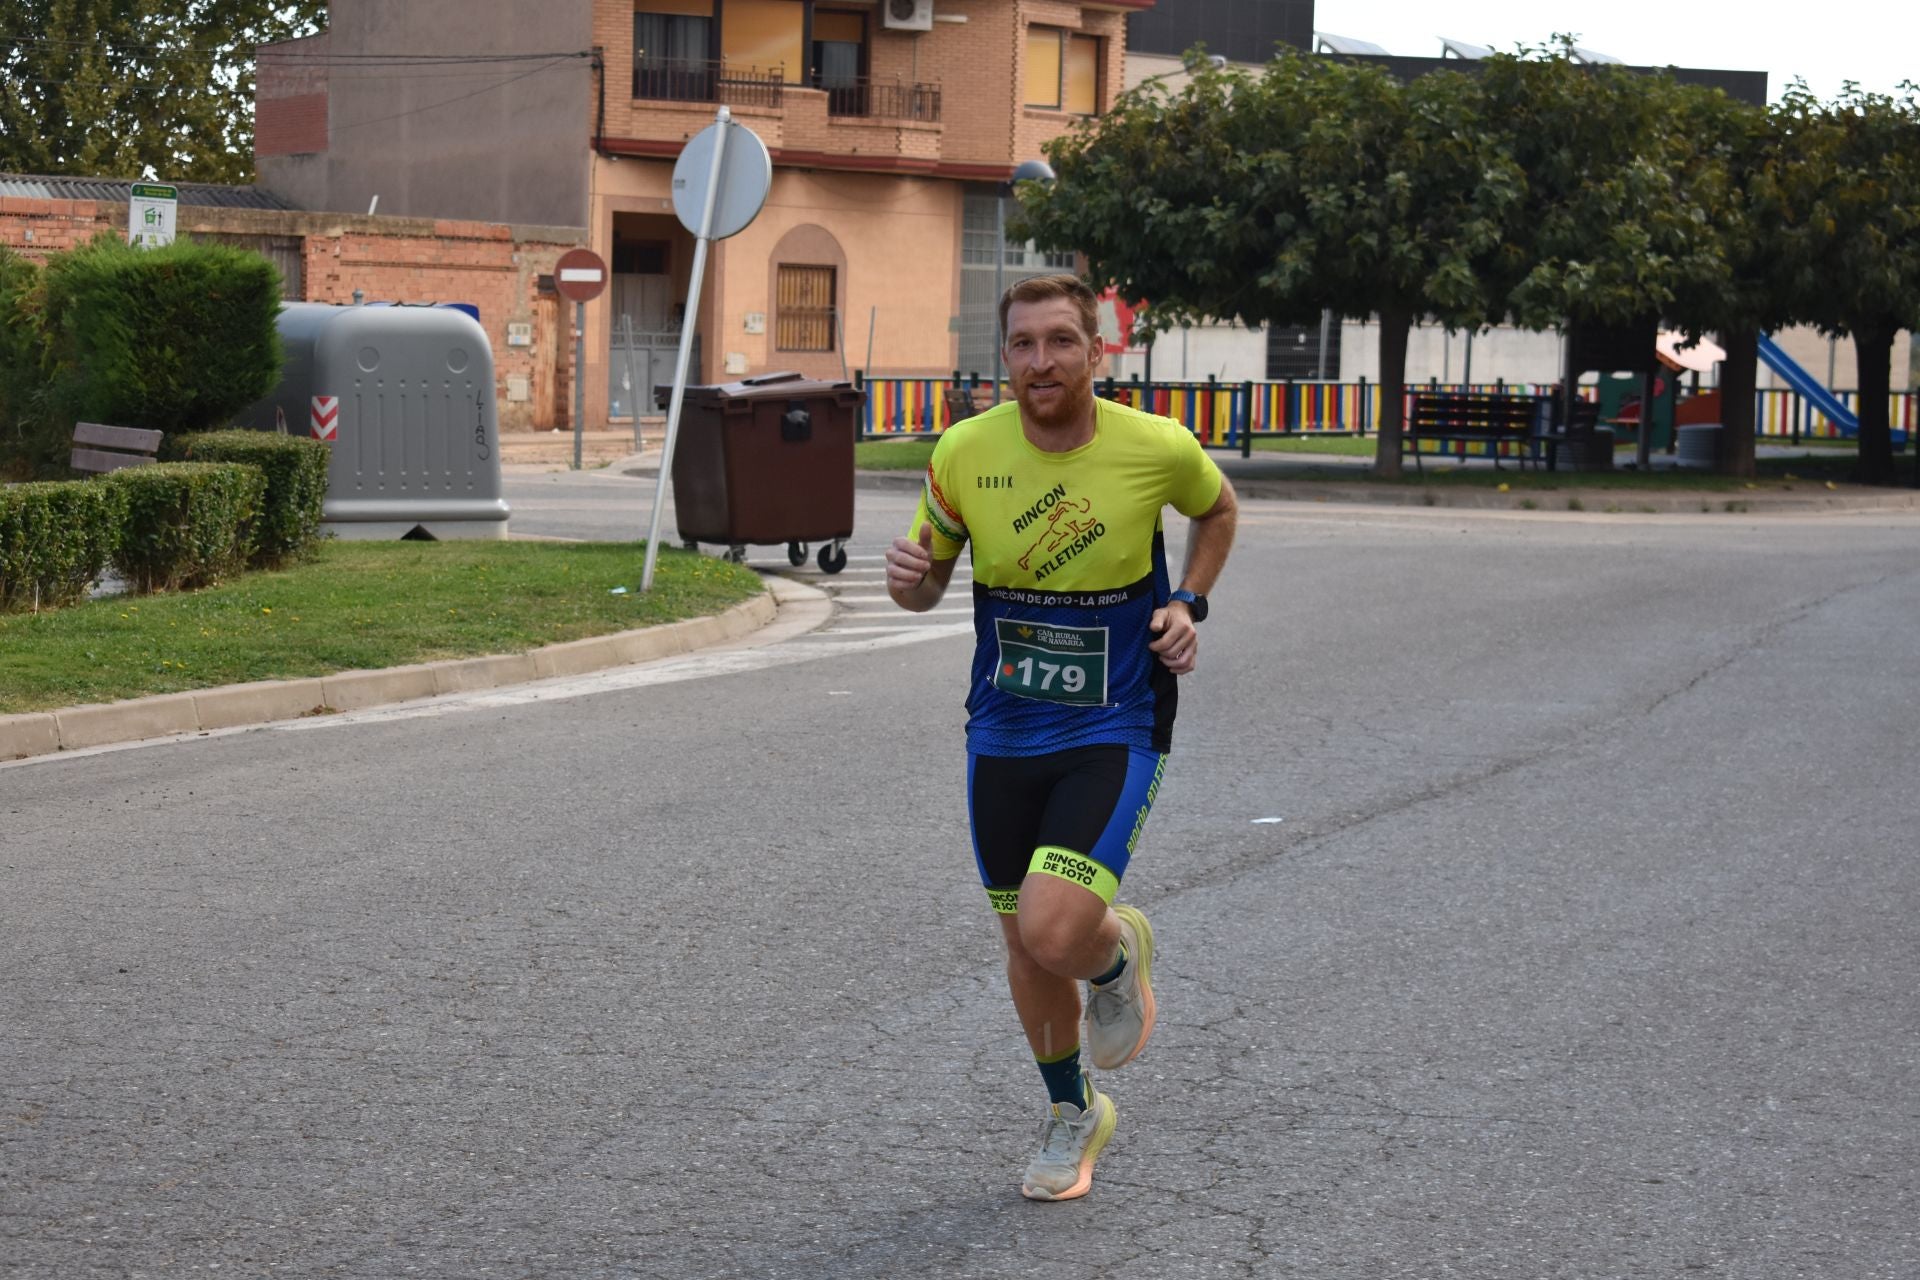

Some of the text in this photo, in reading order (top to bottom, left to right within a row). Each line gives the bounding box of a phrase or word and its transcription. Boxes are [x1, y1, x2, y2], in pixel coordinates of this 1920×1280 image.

[977, 475, 1013, 489] GOBIK
[1012, 483, 1067, 534] RINCON
[1034, 522, 1106, 582] ATLETISMO
[1027, 593, 1041, 604] DE
[1098, 591, 1129, 605] RIOJA
[1037, 629, 1082, 641] CAJA RURAL
[1037, 635, 1085, 647] DE NAVARRA
[1017, 656, 1086, 693] 179
[1147, 752, 1169, 806] ATLETIS
[1042, 861, 1093, 886] DE SOTO
[1045, 851, 1098, 877] RINCÓN
[1001, 902, 1018, 911] SOT
